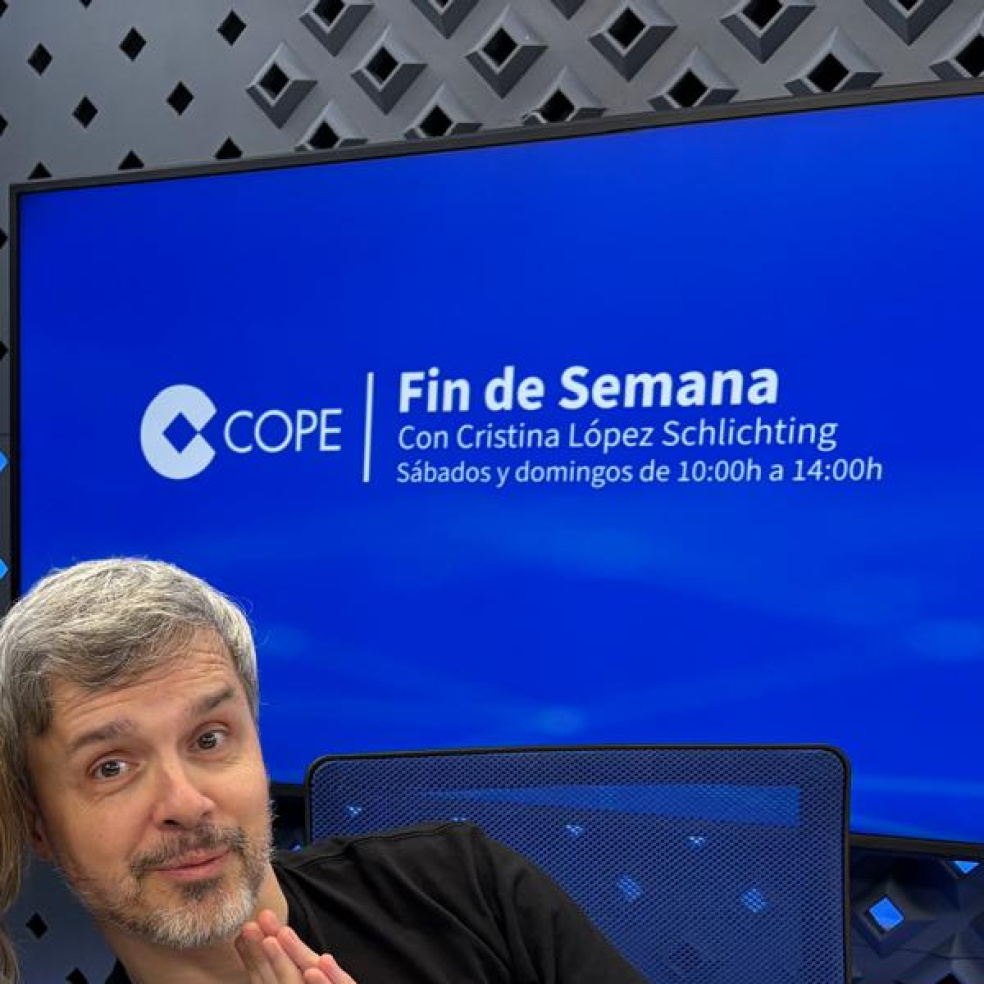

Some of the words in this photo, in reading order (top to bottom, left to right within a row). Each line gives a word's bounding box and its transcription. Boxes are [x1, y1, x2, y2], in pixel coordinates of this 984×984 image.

[399, 366, 470, 414] Fin
[484, 365, 545, 411] de
[558, 365, 779, 410] Semana
[223, 407, 343, 454] COPE
[398, 425, 449, 450] Con
[456, 422, 560, 449] Cristina
[568, 418, 655, 454] López
[661, 416, 839, 452] Schlichting
[396, 460, 491, 483] Sábados
[496, 466, 511, 488] y
[514, 460, 634, 488] domingos
[639, 458, 670, 483] de
[677, 458, 762, 483] 10:00h
[768, 463, 784, 482] a
[792, 456, 883, 482] 14:00h
